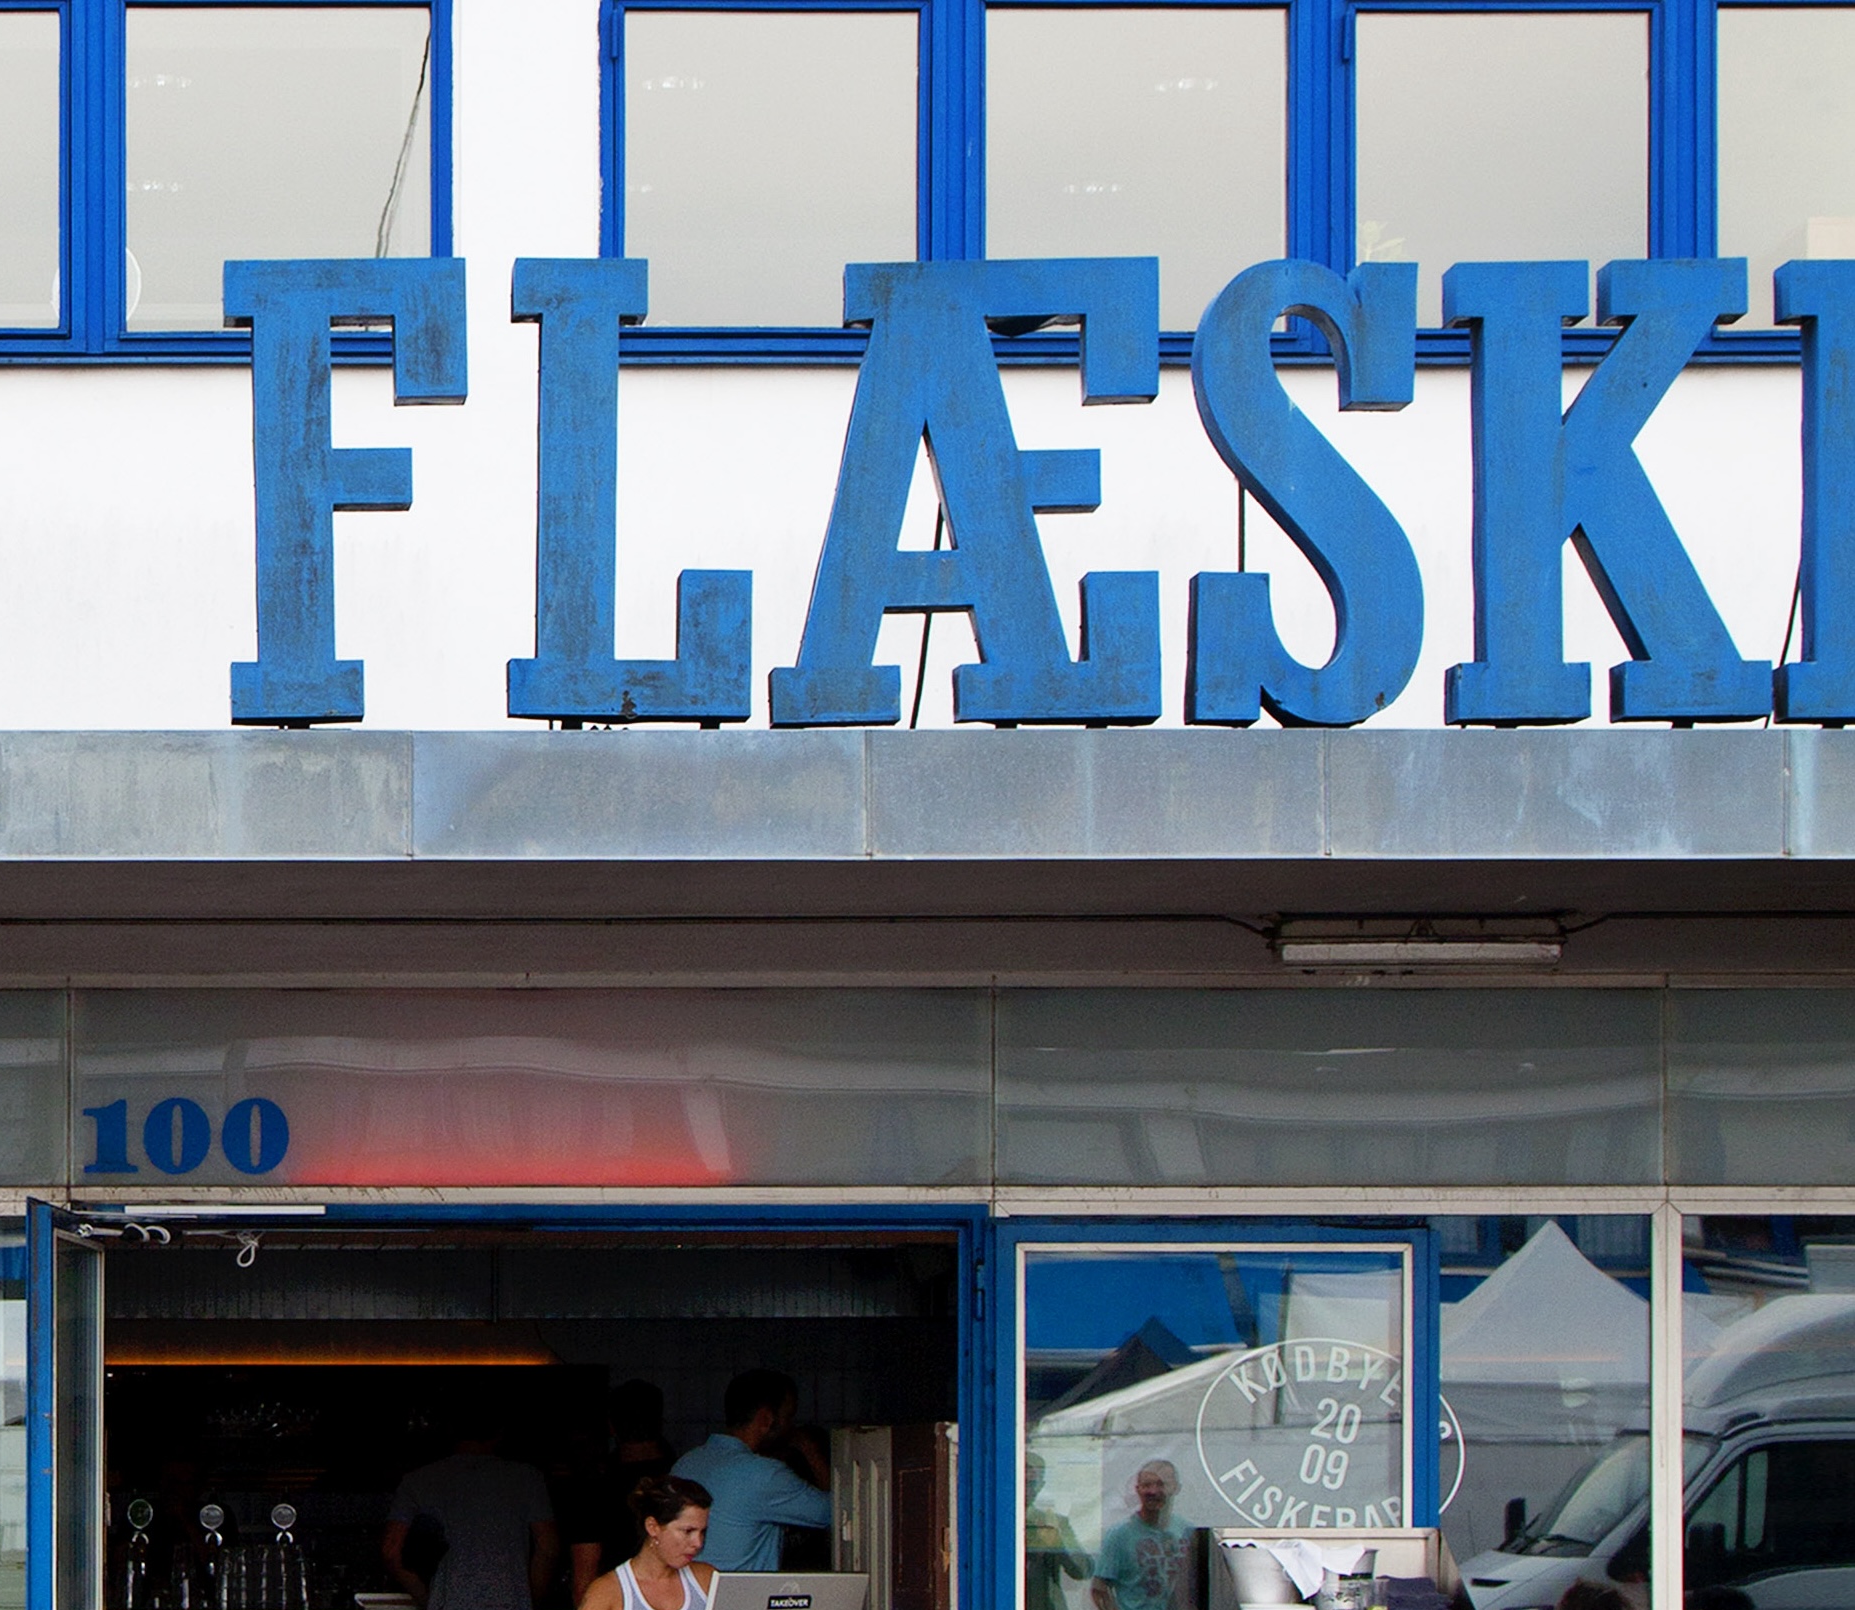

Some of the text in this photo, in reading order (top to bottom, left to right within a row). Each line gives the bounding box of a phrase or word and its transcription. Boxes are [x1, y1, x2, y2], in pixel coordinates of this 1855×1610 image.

[82, 1096, 290, 1176] 100
[1309, 1397, 1362, 1445] 20
[1299, 1443, 1349, 1491] 09
